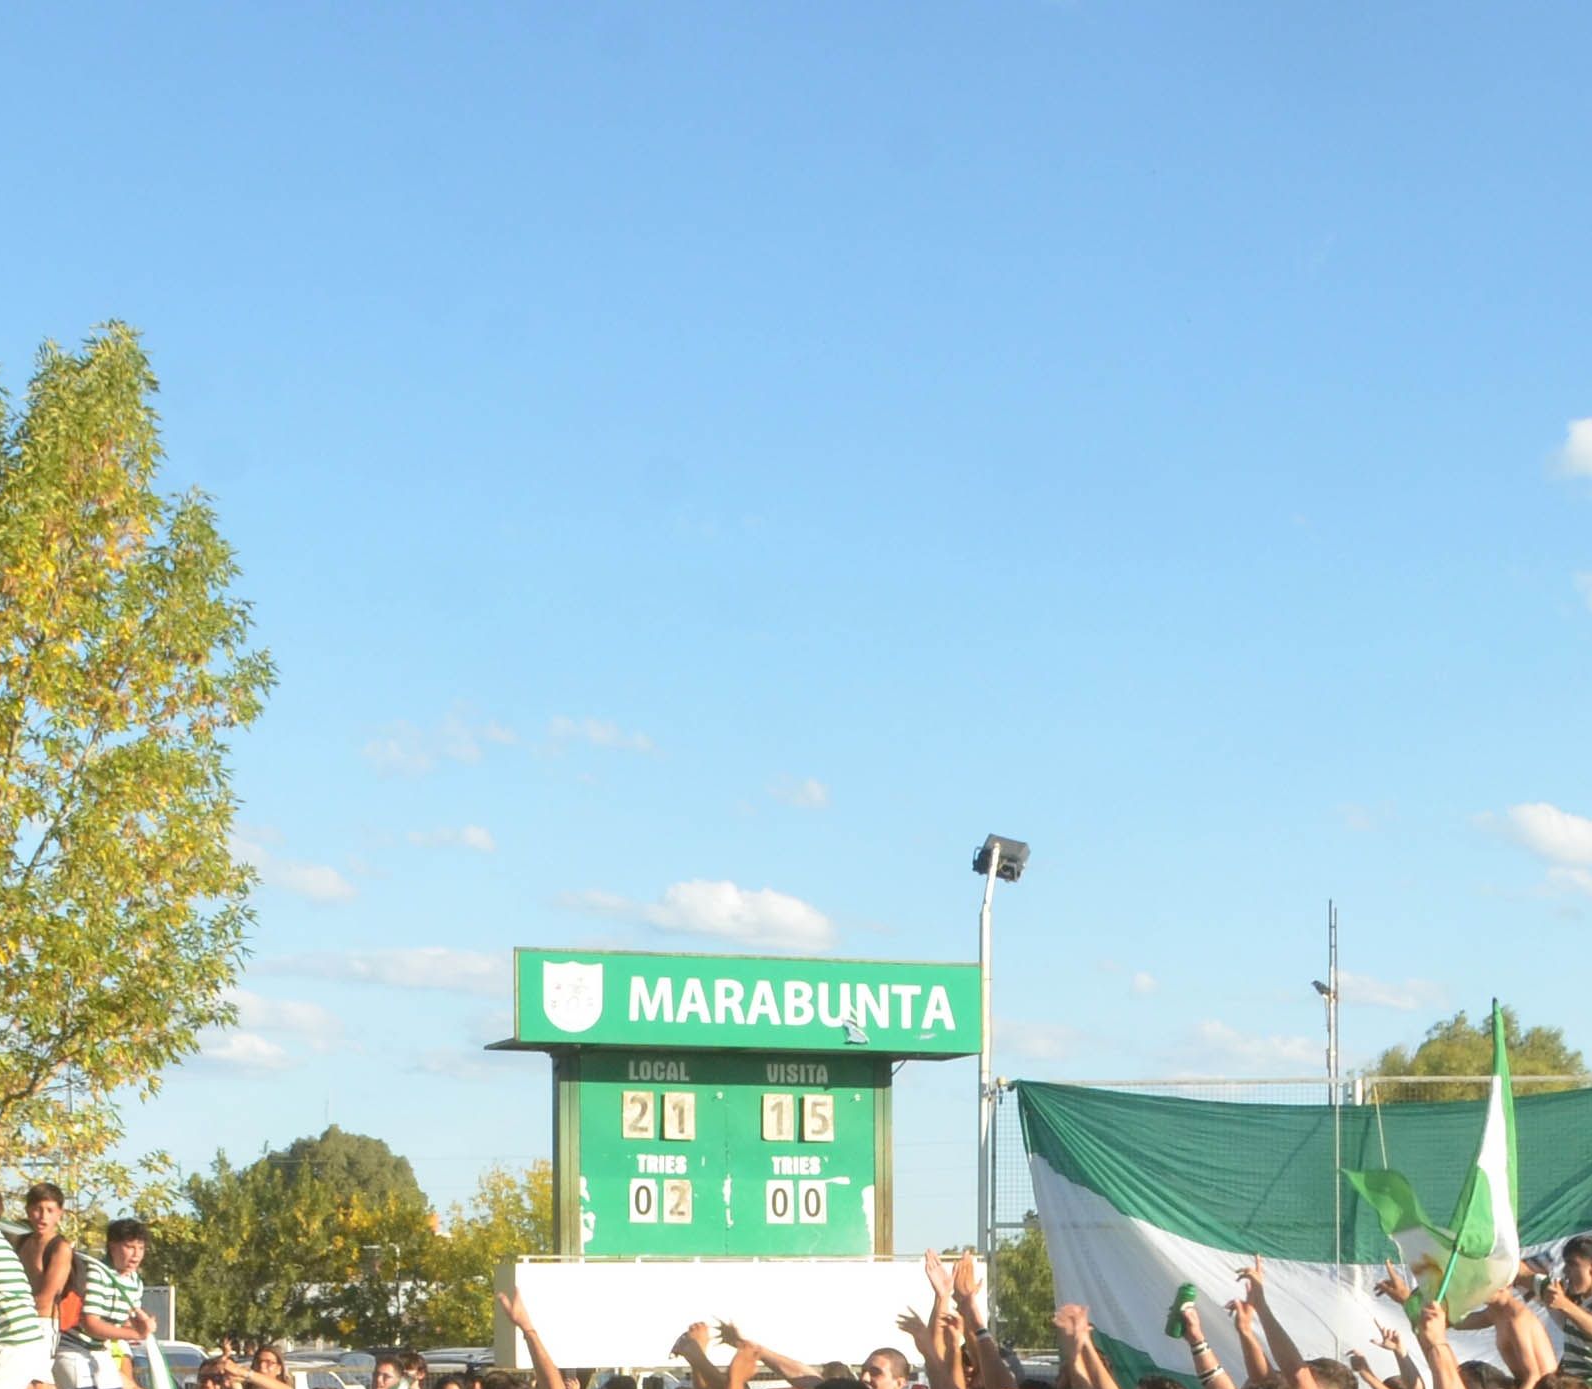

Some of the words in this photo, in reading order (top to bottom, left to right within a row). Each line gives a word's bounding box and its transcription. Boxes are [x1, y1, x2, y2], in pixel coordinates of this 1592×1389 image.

[628, 975, 956, 1031] MARABUNTA
[628, 1060, 690, 1082] LOCAL
[766, 1063, 829, 1085] VISITA
[637, 1154, 687, 1174] TRIES
[771, 1156, 821, 1175] TRIES
